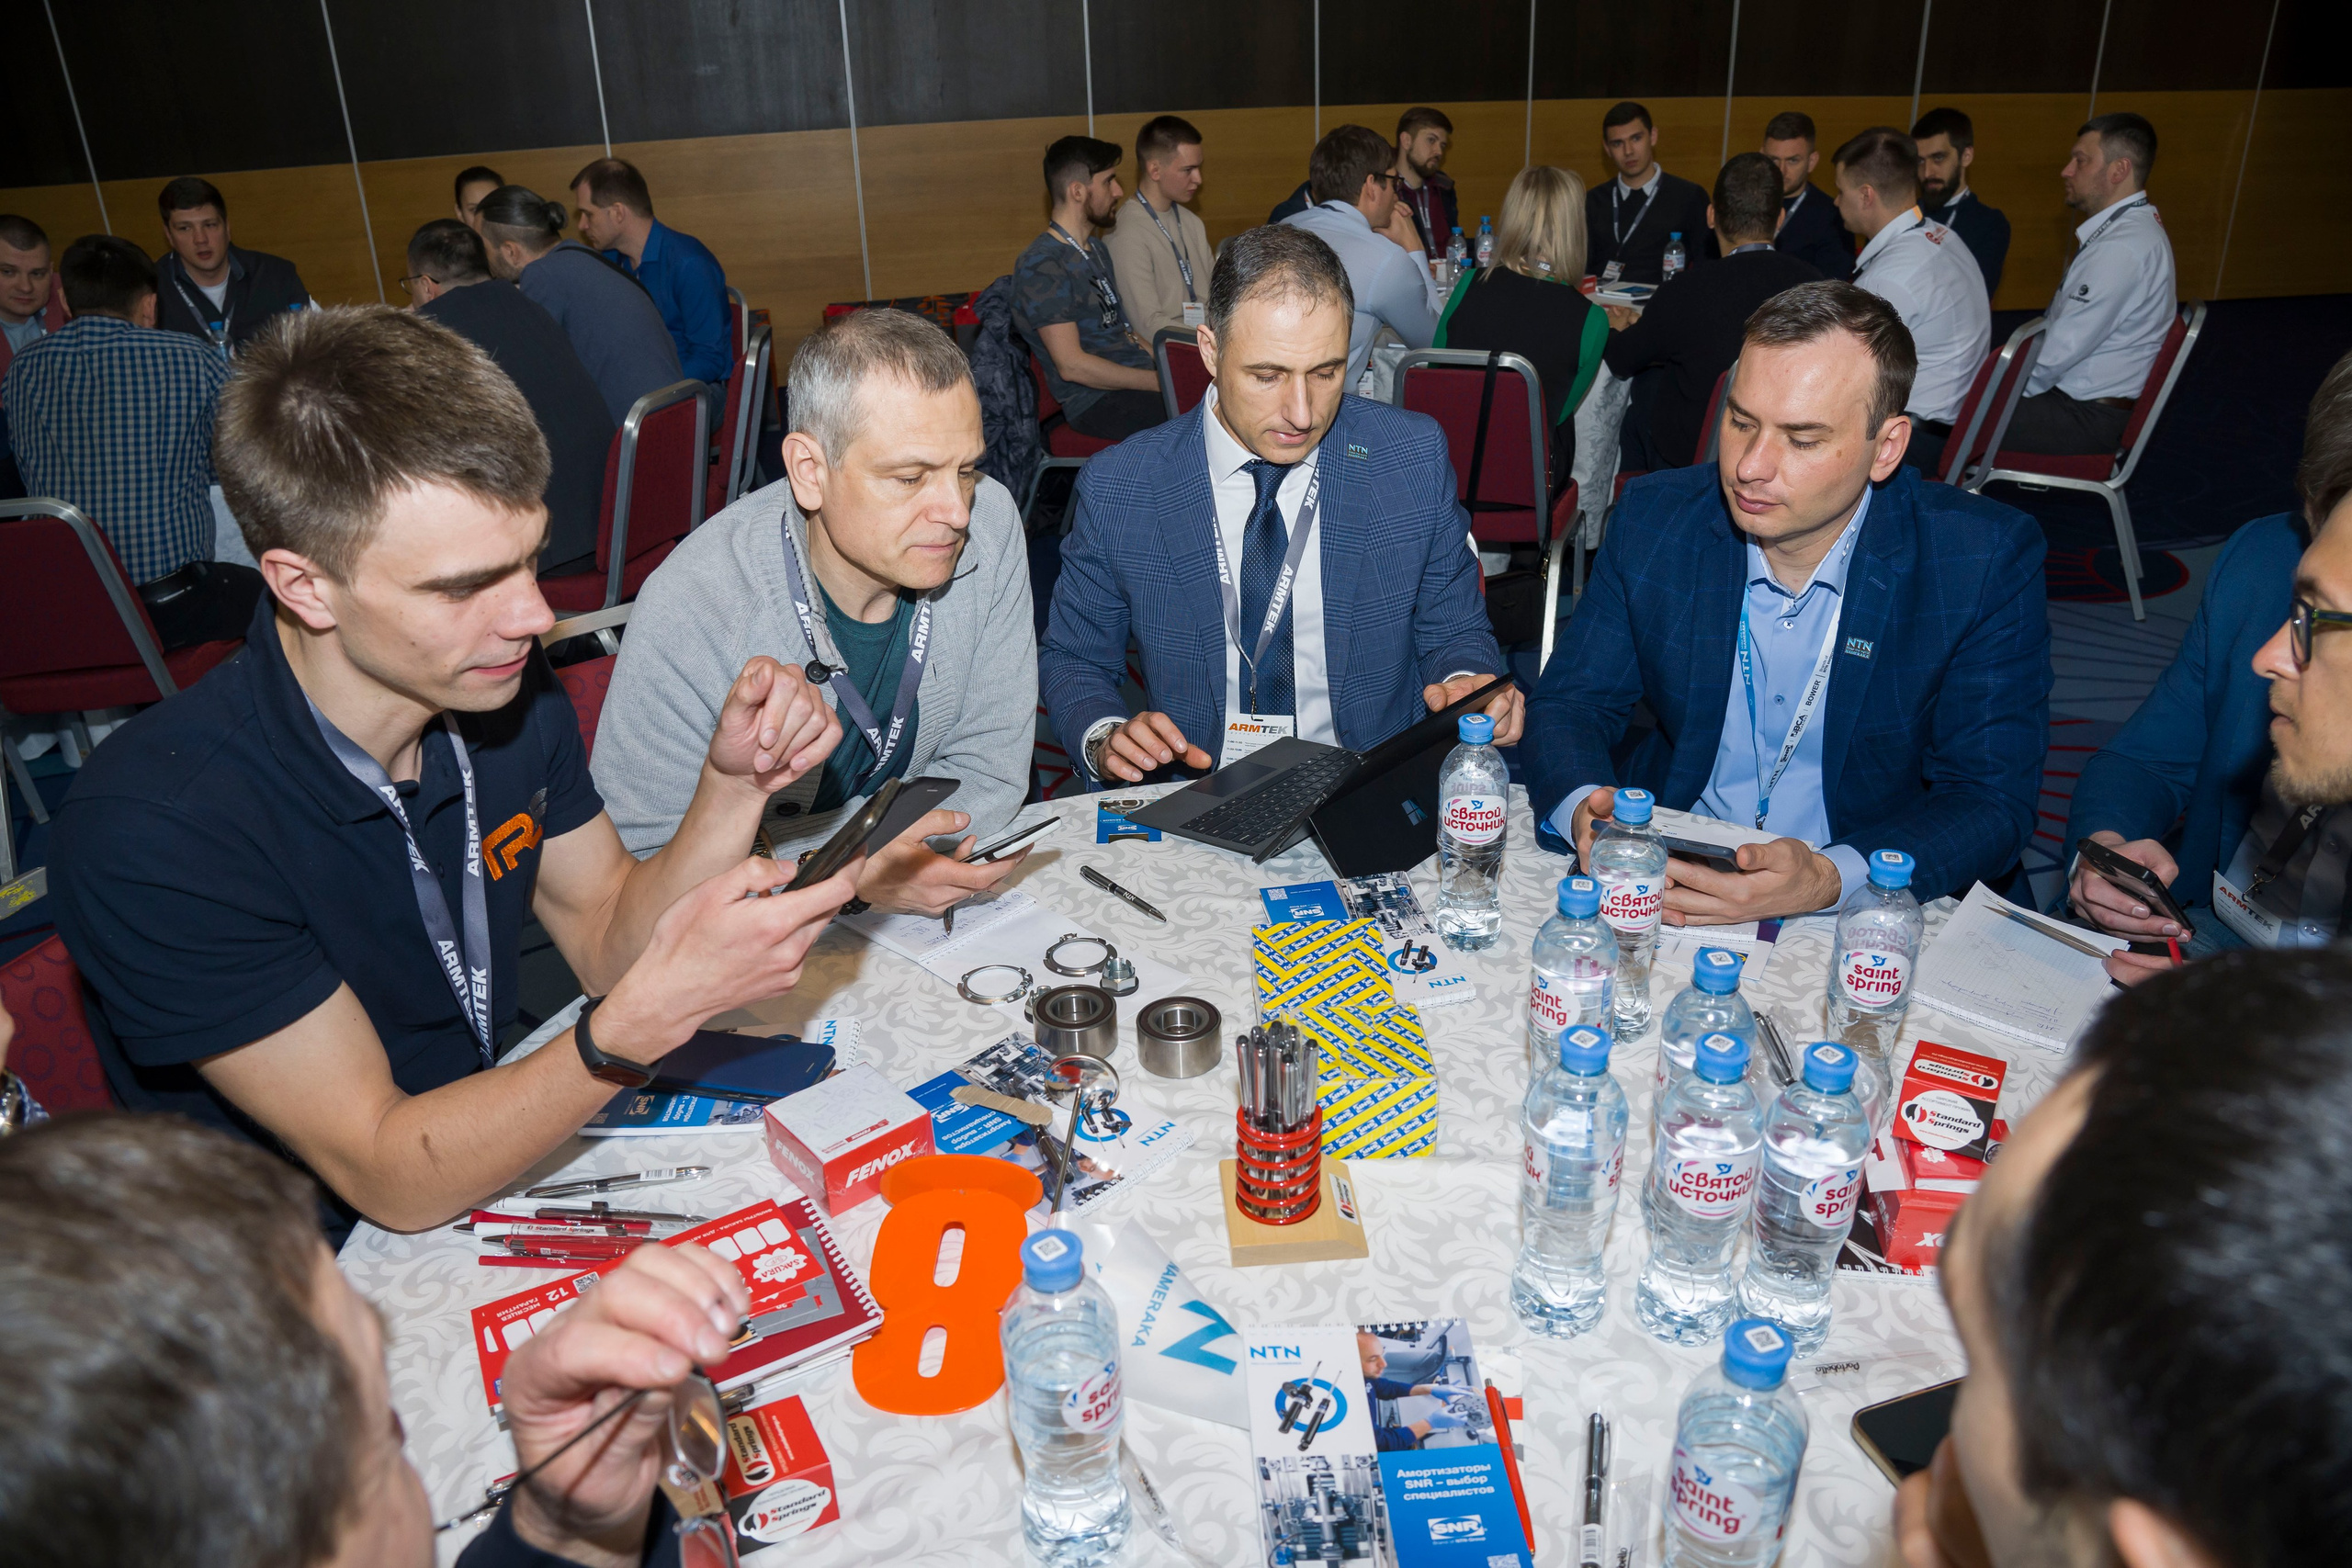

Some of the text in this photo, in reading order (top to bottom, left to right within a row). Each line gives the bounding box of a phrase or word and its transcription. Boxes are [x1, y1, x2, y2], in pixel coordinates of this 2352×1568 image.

[2086, 220, 2111, 245] ARMTEK
[1067, 237, 1089, 260] ARMTEK
[1102, 280, 1117, 304] ARMTEK
[1348, 443, 1368, 454] NTN
[1263, 563, 1295, 634] ARMTEK
[1847, 636, 1872, 652] NTN
[1741, 651, 1751, 685] NTN
[1806, 680, 1821, 706] BOWER
[1228, 723, 1288, 734] ARMTEK
[1768, 769, 1779, 789] NTN
[462, 770, 480, 877] ARMTEK
[1123, 891, 1136, 901] NTN
[1292, 907, 1323, 918] SNR
[2219, 886, 2274, 931] ARMTEK
[1854, 964, 1900, 980] saint
[1429, 976, 1466, 988] NTN
[1846, 974, 1902, 995] spring
[1530, 998, 1567, 1026] pring
[1917, 1065, 1969, 1082] Standard
[1928, 1063, 1970, 1077] Springs
[635, 1097, 650, 1114] SNR
[935, 1103, 966, 1120] SNR
[942, 1111, 996, 1141] специалистов
[983, 1117, 1002, 1128] SNR
[1928, 1118, 1970, 1134] Springs
[1929, 1110, 1981, 1129] Standard
[951, 1129, 978, 1145] выбор
[954, 1119, 1012, 1151] Амортизаторы
[1139, 1122, 1176, 1146] NTN
[775, 1139, 815, 1182] FENOX
[845, 1139, 916, 1189] FENOX
[719, 1218, 744, 1231] SAKURA
[744, 1208, 773, 1222] ФИЛЬТРЫ
[761, 1258, 800, 1279] SAKURA
[545, 1287, 569, 1301] 12
[853, 1189, 1027, 1416] 8
[496, 1297, 539, 1318] ГАРАНТИЯ
[501, 1303, 541, 1322] МЕСЯЦЕВ
[1250, 1346, 1300, 1359] NTN
[1815, 1362, 1860, 1375] Portobello
[727, 1422, 751, 1463] Standard
[743, 1425, 762, 1459] Springs
[1396, 1463, 1492, 1479] Амортизаторы
[1405, 1479, 1433, 1490] SNR
[1446, 1474, 1488, 1488] выбор
[1678, 1466, 1734, 1513] saint
[770, 1489, 826, 1514] Standard
[1403, 1485, 1495, 1501] специалистов
[772, 1502, 817, 1523] Springs
[1430, 1519, 1481, 1534] SNR
